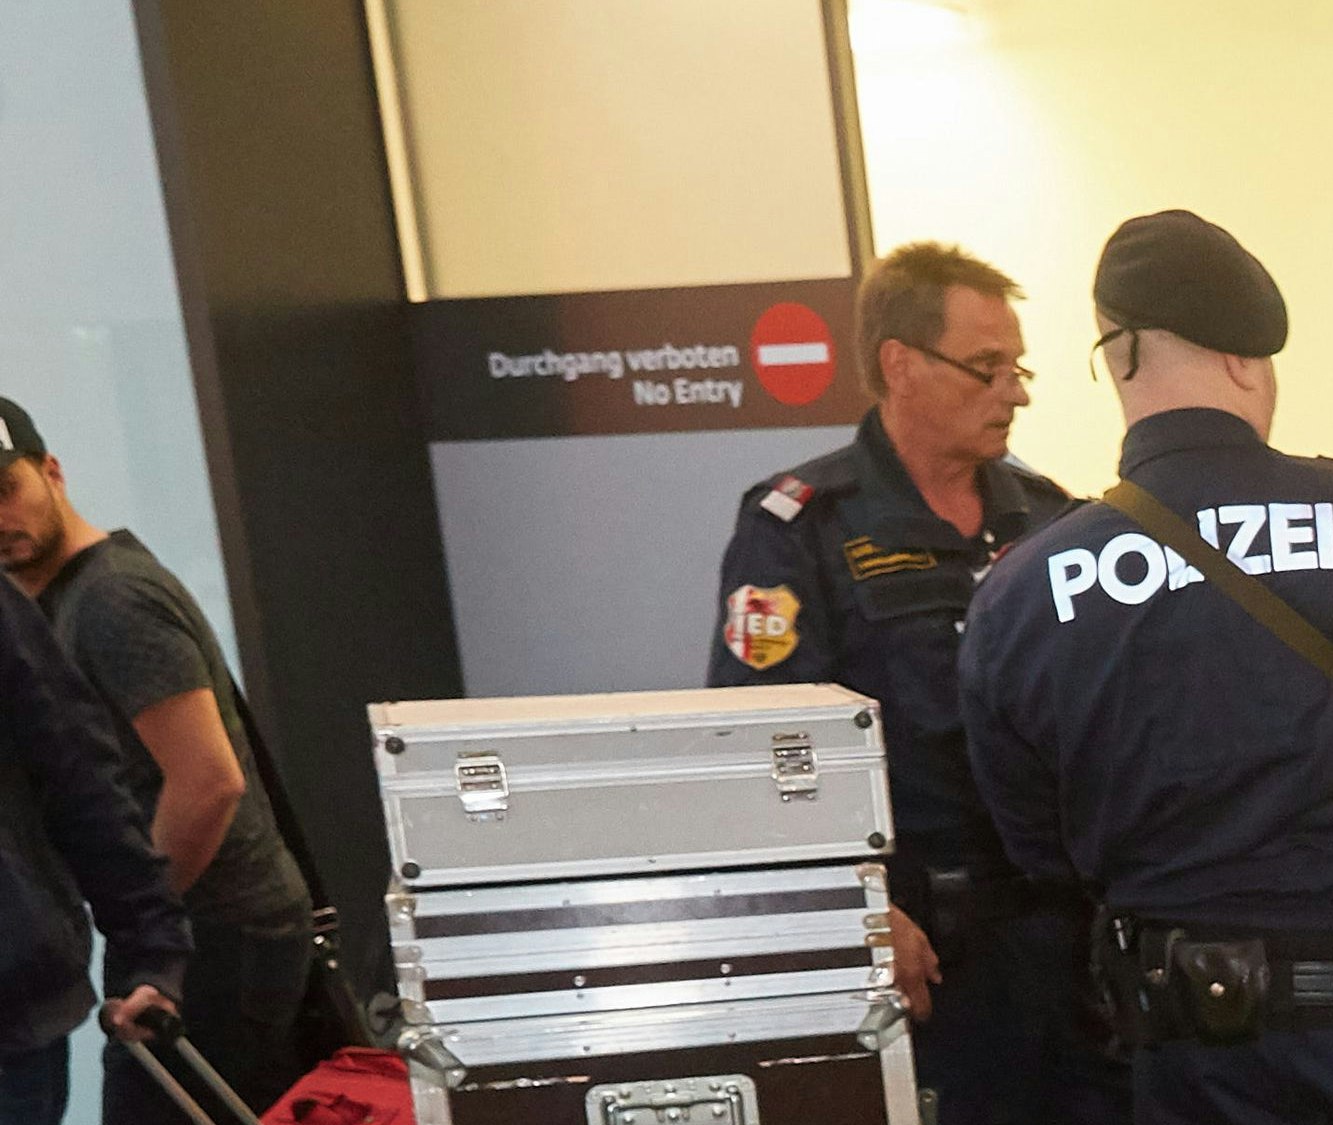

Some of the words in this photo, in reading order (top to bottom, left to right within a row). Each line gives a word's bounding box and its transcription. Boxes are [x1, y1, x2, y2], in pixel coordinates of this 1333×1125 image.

[488, 350, 625, 382] Durchgang
[626, 343, 740, 371] verboten
[633, 380, 672, 405] No
[674, 377, 744, 408] Entry
